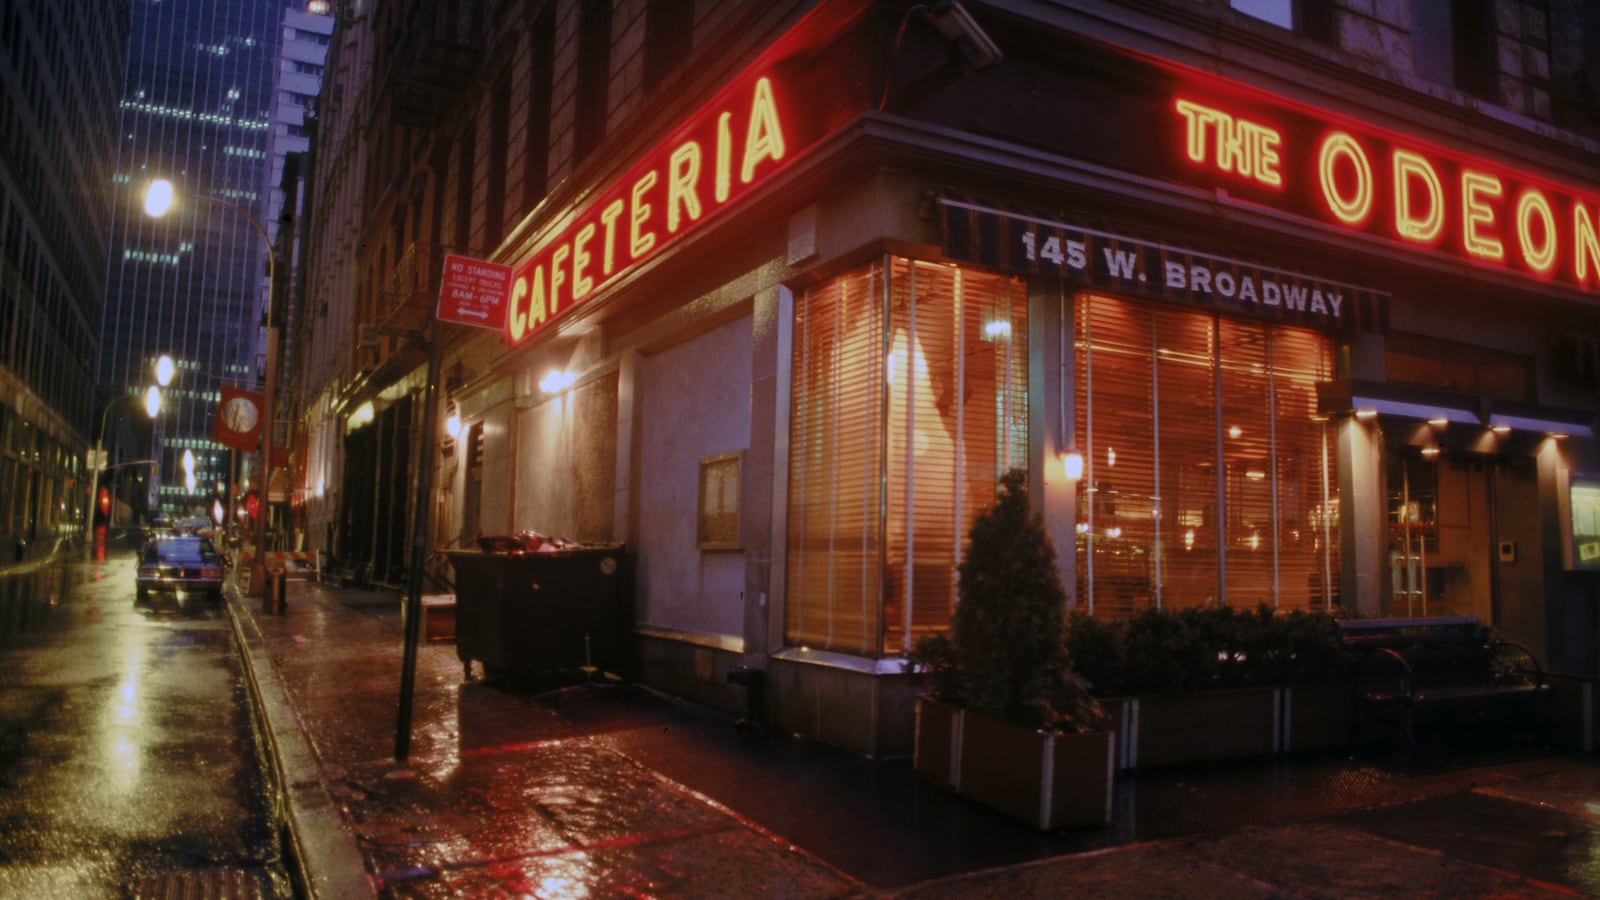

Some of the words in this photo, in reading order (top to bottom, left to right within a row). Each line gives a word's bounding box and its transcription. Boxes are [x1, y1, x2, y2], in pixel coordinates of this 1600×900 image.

[509, 77, 785, 341] CAFETERIA
[1176, 100, 1282, 186] THE
[1319, 132, 1600, 280] ODEON
[452, 263, 463, 272] NO
[467, 266, 505, 280] STANDING
[1022, 231, 1087, 270] 145
[1104, 248, 1147, 282] W.
[1165, 261, 1344, 317] BROADWAY
